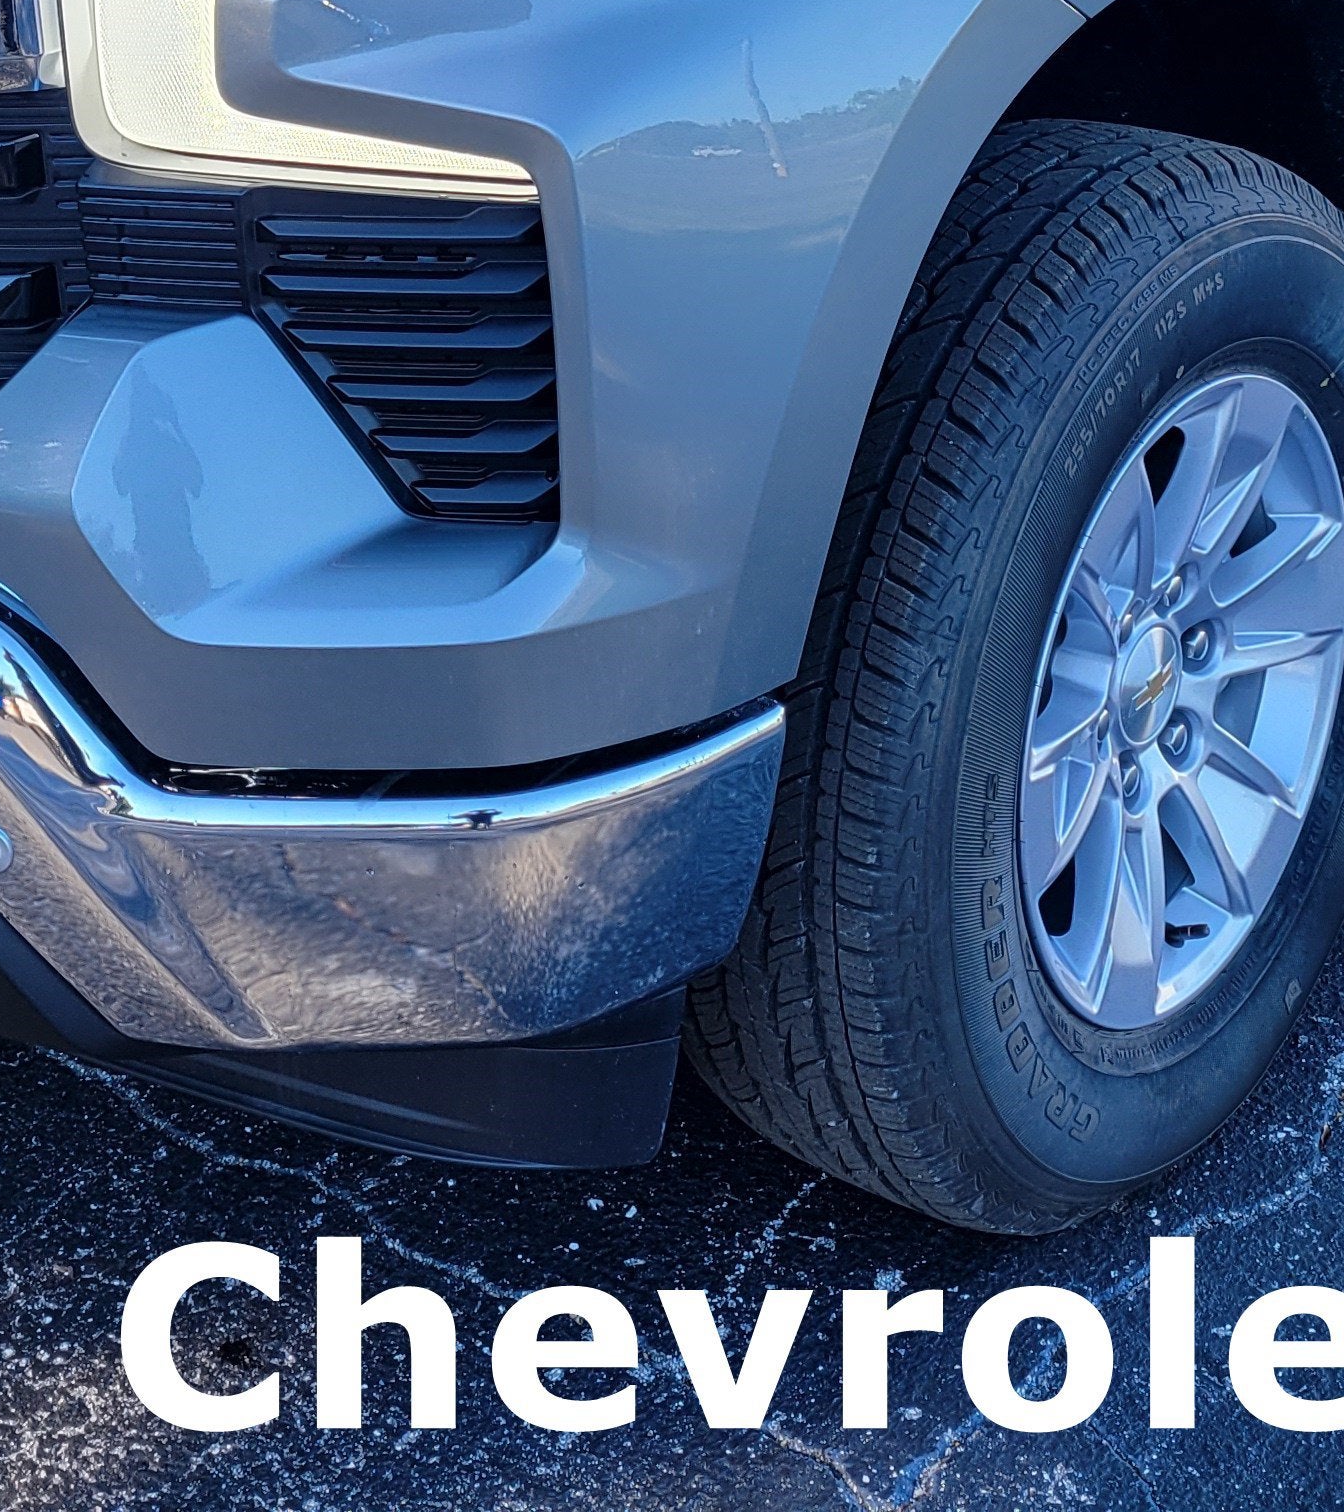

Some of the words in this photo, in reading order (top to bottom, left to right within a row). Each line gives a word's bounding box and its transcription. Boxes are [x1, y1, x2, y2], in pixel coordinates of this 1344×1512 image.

[1096, 318, 1130, 358] SPEC
[1154, 300, 1187, 340] 112S
[1192, 272, 1225, 306] M+S
[980, 874, 1102, 1145] GRABBER
